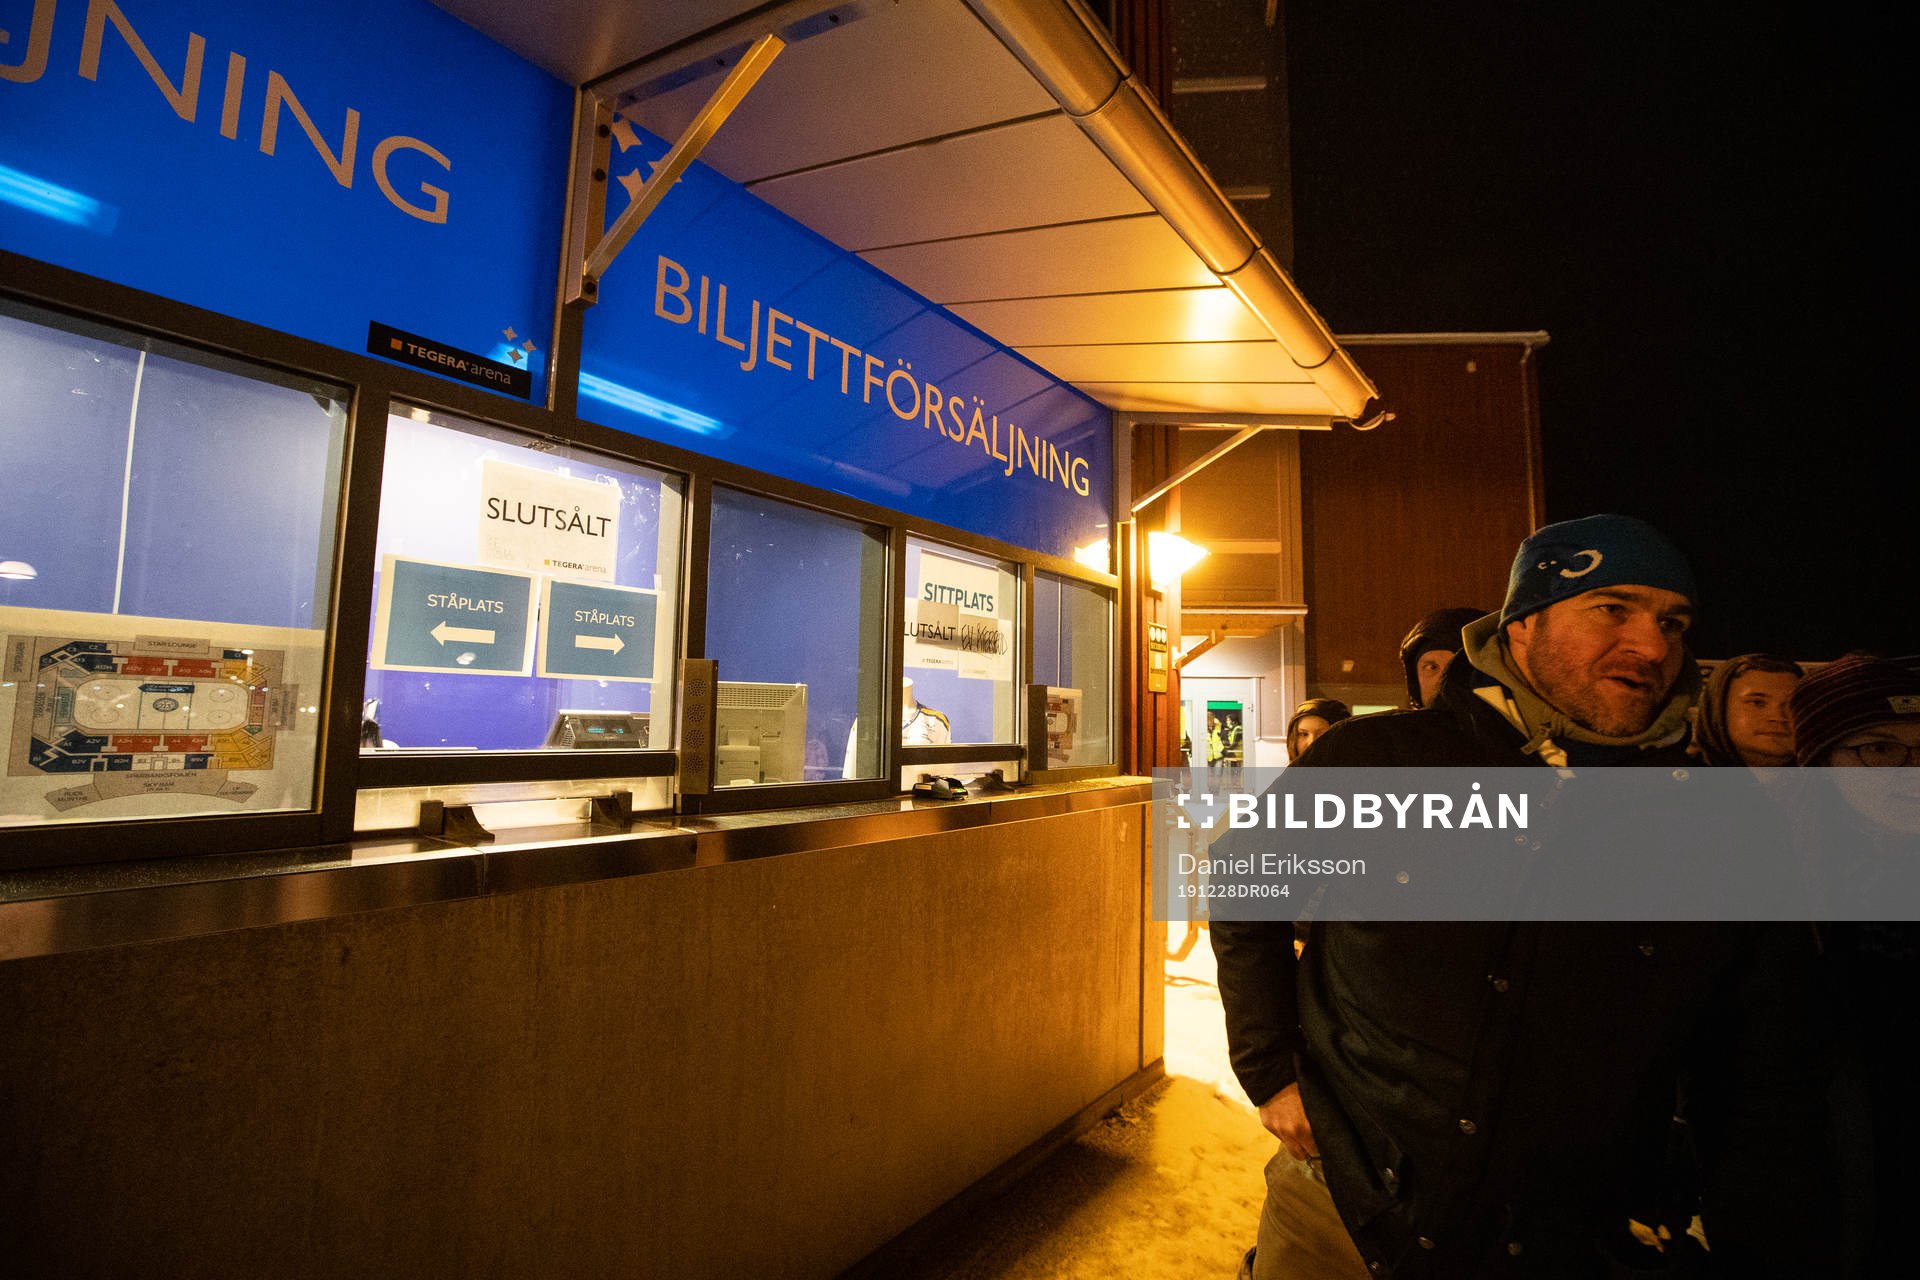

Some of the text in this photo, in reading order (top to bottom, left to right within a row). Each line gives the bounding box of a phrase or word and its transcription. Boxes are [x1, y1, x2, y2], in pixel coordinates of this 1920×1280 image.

[0, 0, 452, 224] JNING
[407, 342, 512, 386] TEGERA arena
[654, 255, 1090, 497] BILJETTFÖRSÄLJNING
[487, 497, 611, 538] SLUTSÅLT
[427, 593, 503, 614] STÅPLATS
[923, 582, 994, 613] SITTPLATS
[574, 609, 635, 628] STÅPLATS
[904, 620, 956, 641] LUTSÅLT
